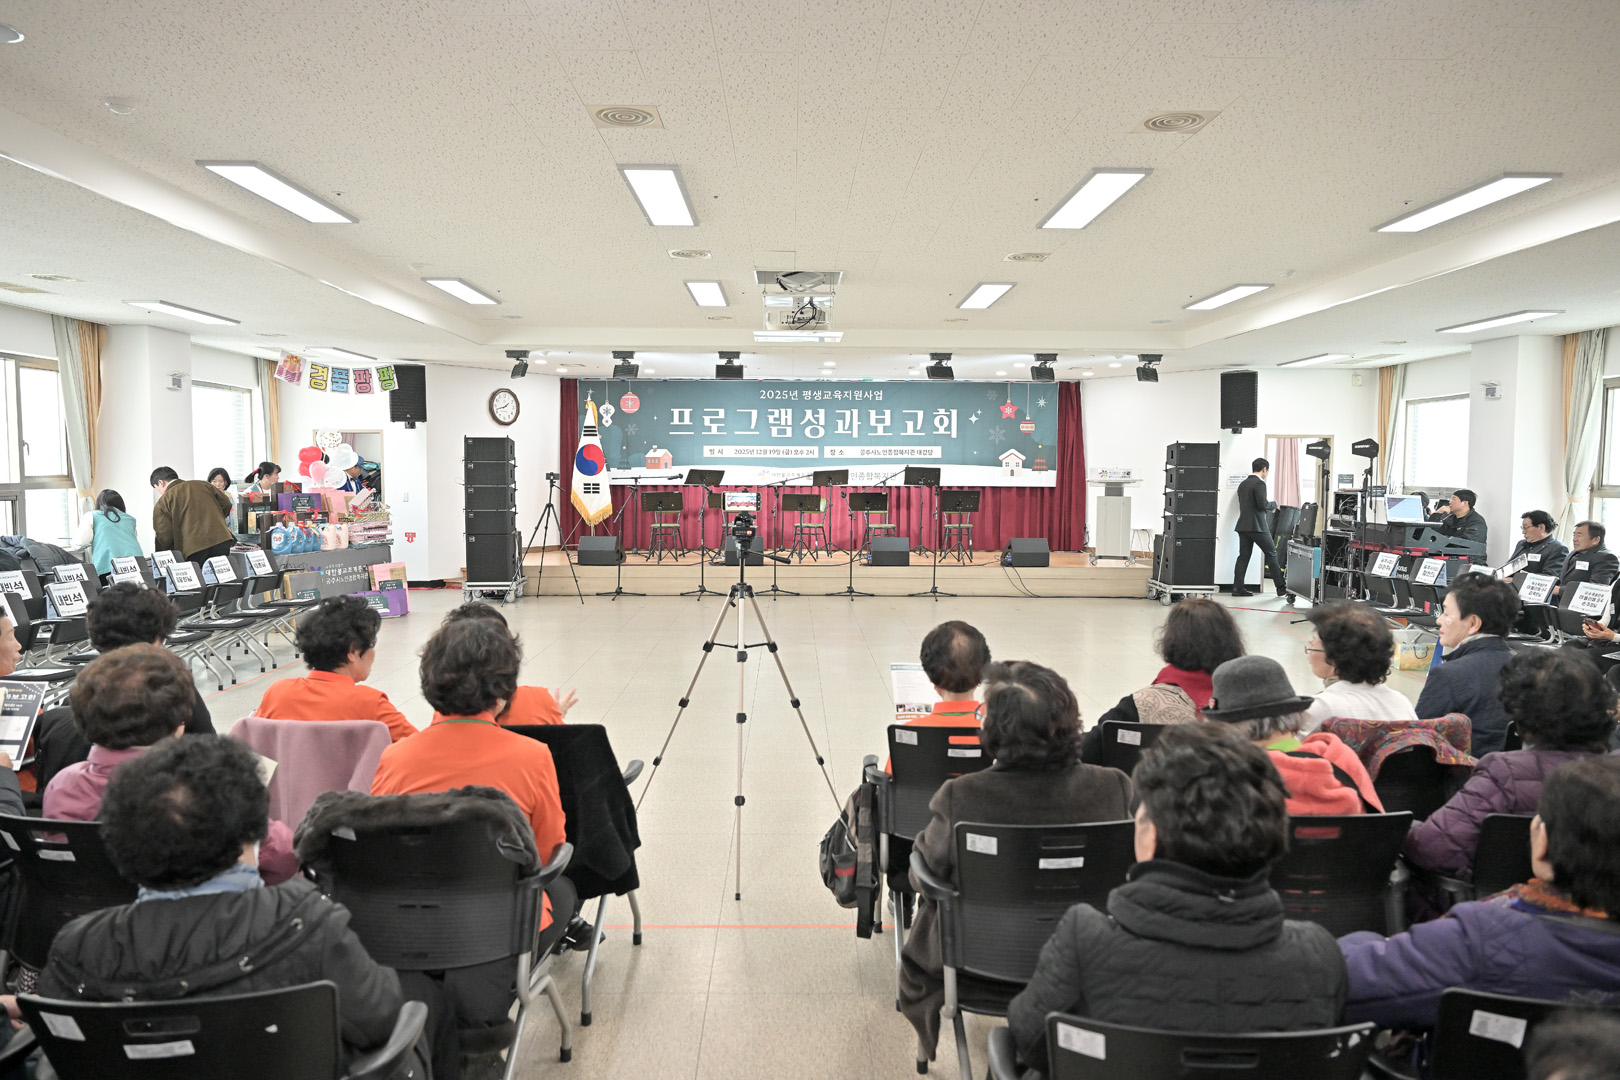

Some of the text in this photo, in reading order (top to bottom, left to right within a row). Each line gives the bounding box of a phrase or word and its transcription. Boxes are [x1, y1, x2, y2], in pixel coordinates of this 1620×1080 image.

[760, 390, 883, 400] 2025년 평생교육지원사업
[669, 408, 958, 439] 프로그램성과보고회
